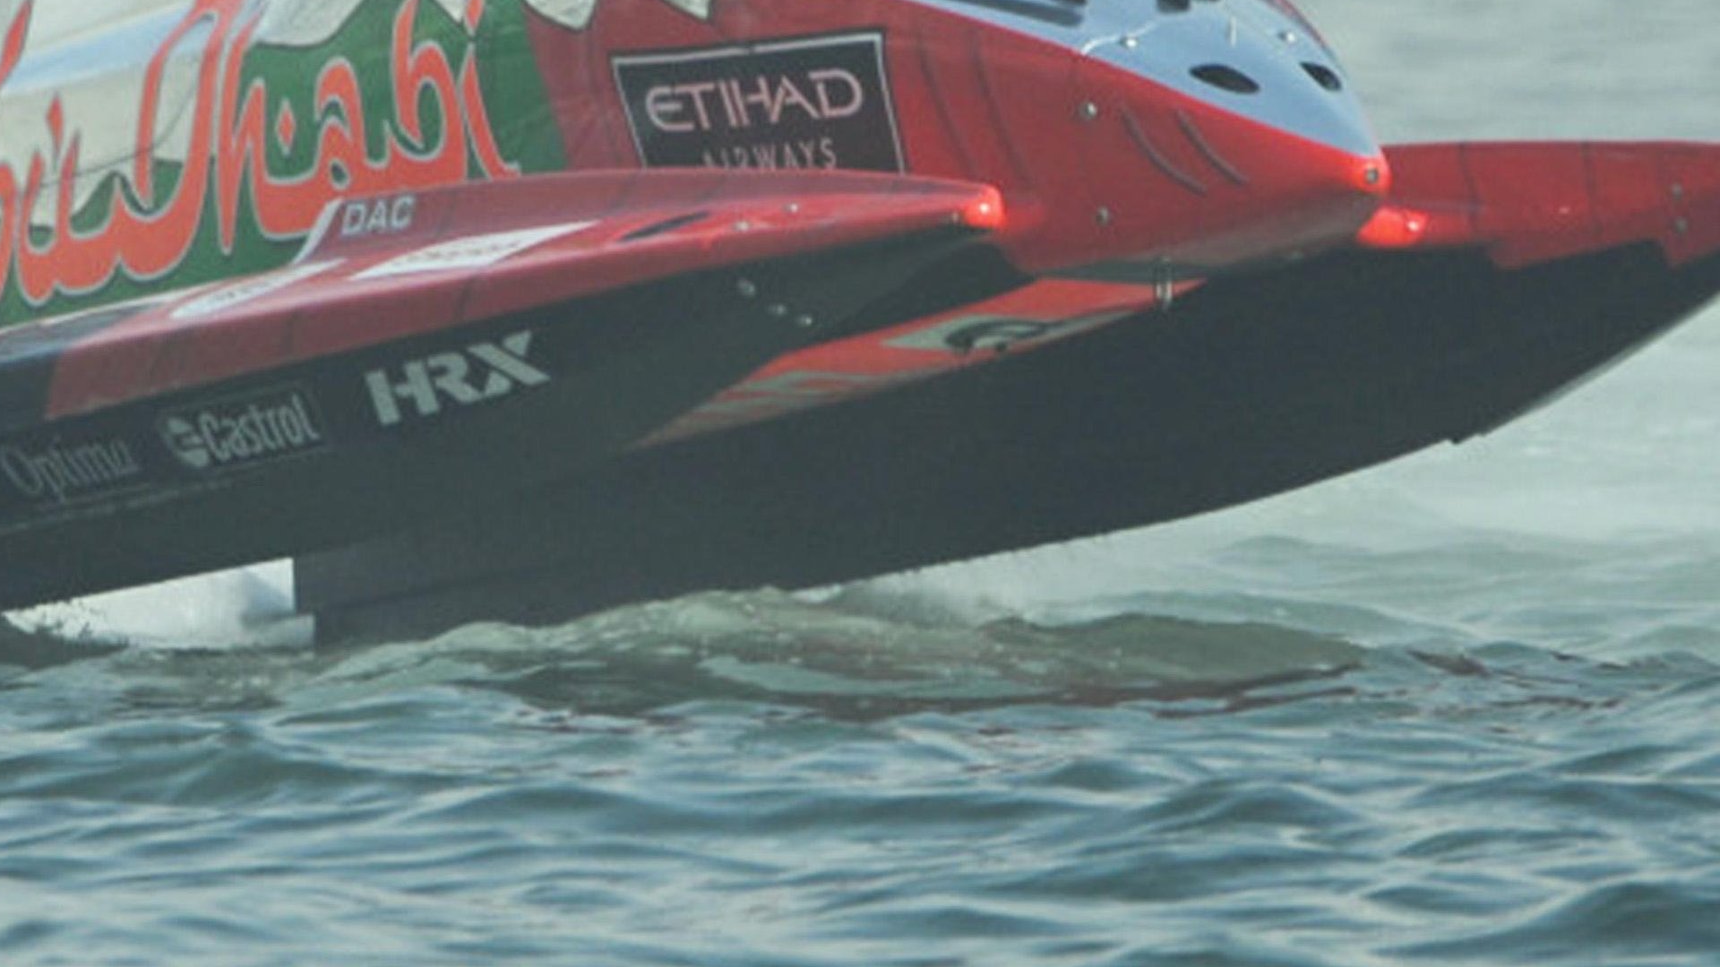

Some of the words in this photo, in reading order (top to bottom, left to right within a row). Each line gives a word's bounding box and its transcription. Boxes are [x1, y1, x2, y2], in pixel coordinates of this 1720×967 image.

[644, 67, 864, 133] ETIHAD
[340, 194, 417, 236] DAC
[365, 330, 550, 427] HRX
[198, 393, 321, 461] Castrol
